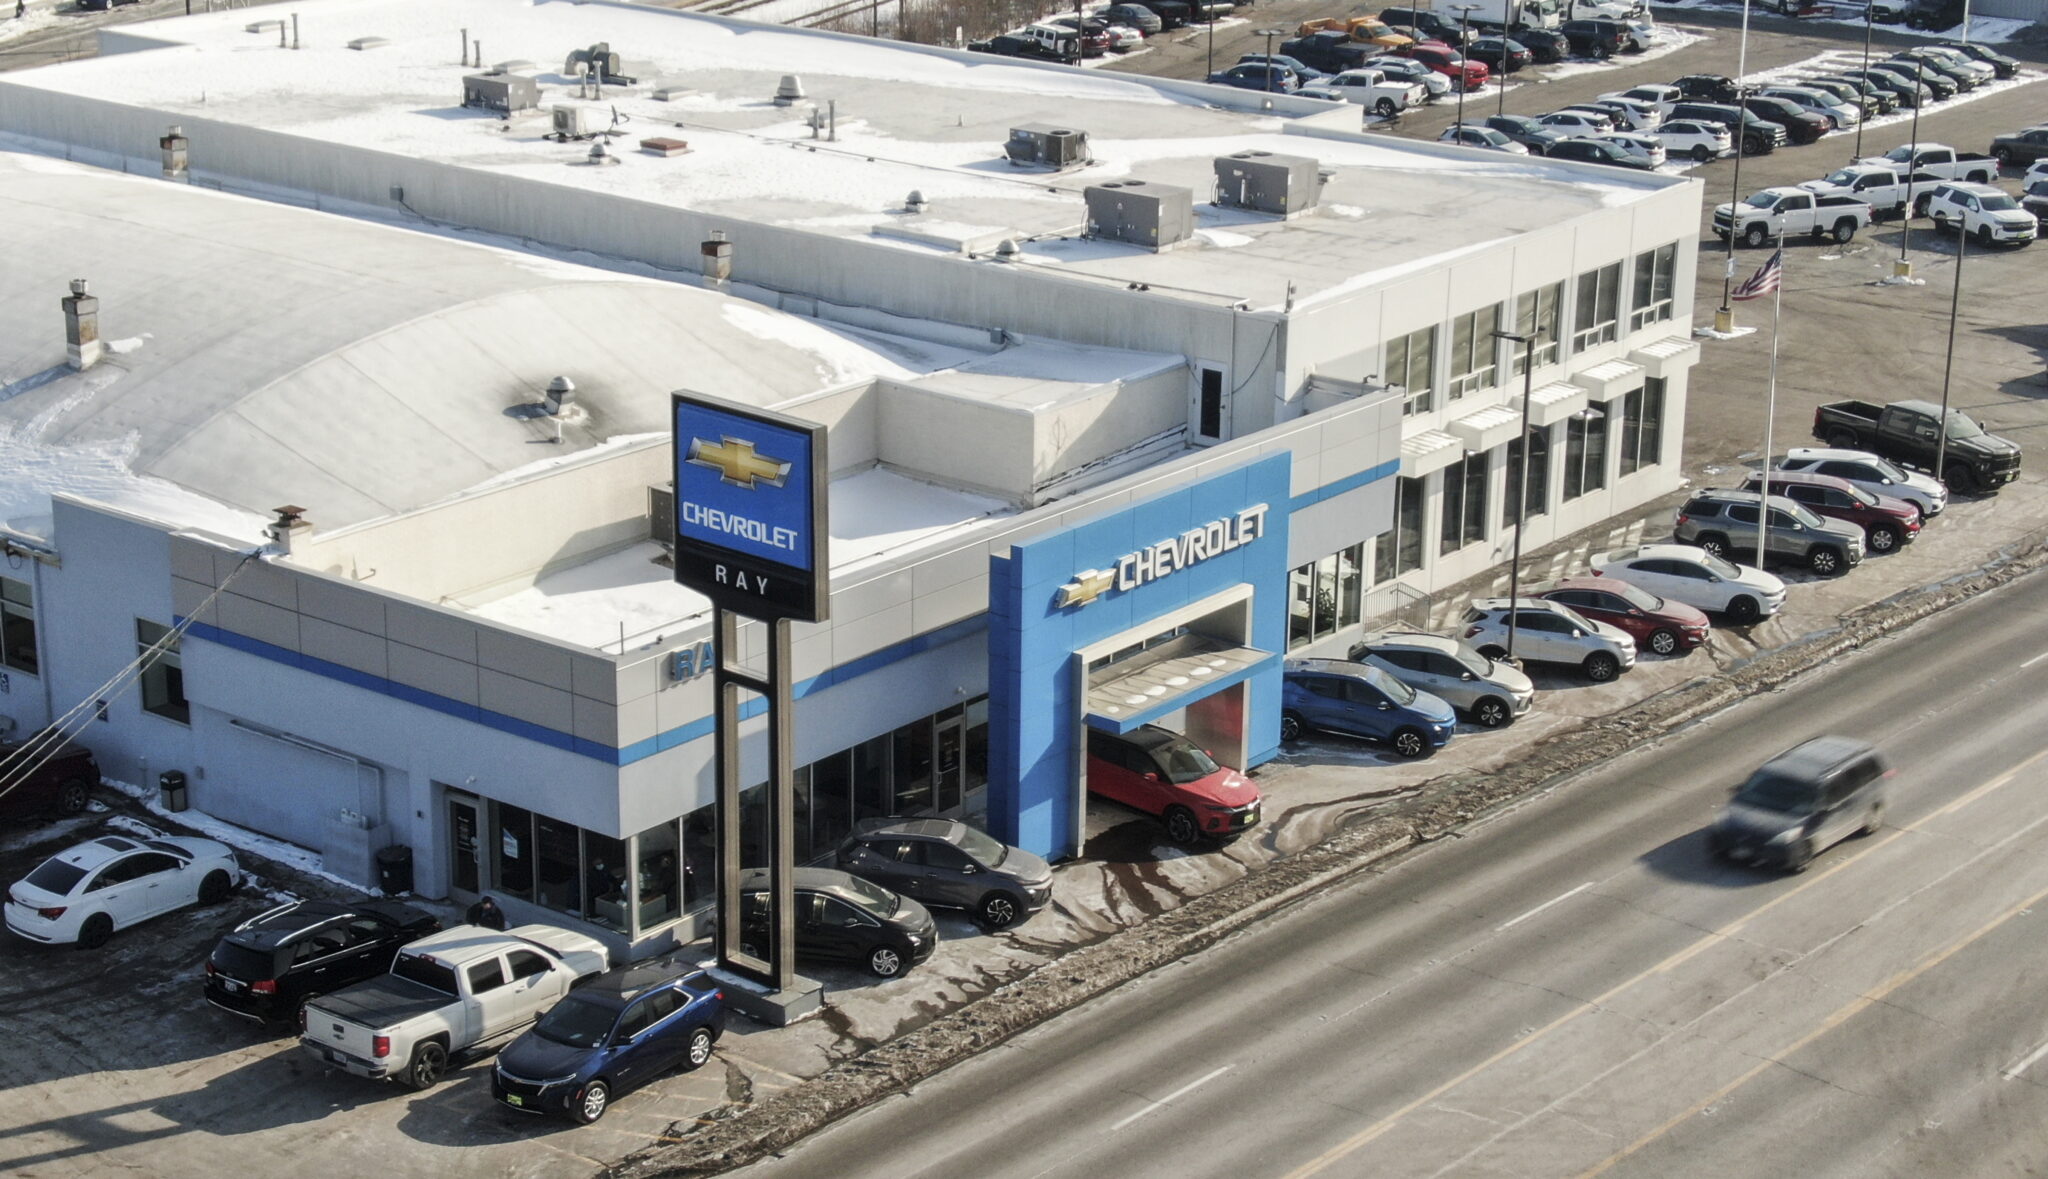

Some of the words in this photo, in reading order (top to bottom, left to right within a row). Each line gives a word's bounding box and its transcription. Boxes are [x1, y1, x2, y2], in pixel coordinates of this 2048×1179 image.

[683, 501, 798, 551] CHEVROLET
[1118, 503, 1269, 592] CHEVROLET
[715, 564, 768, 595] RAY
[674, 641, 716, 681] RA
